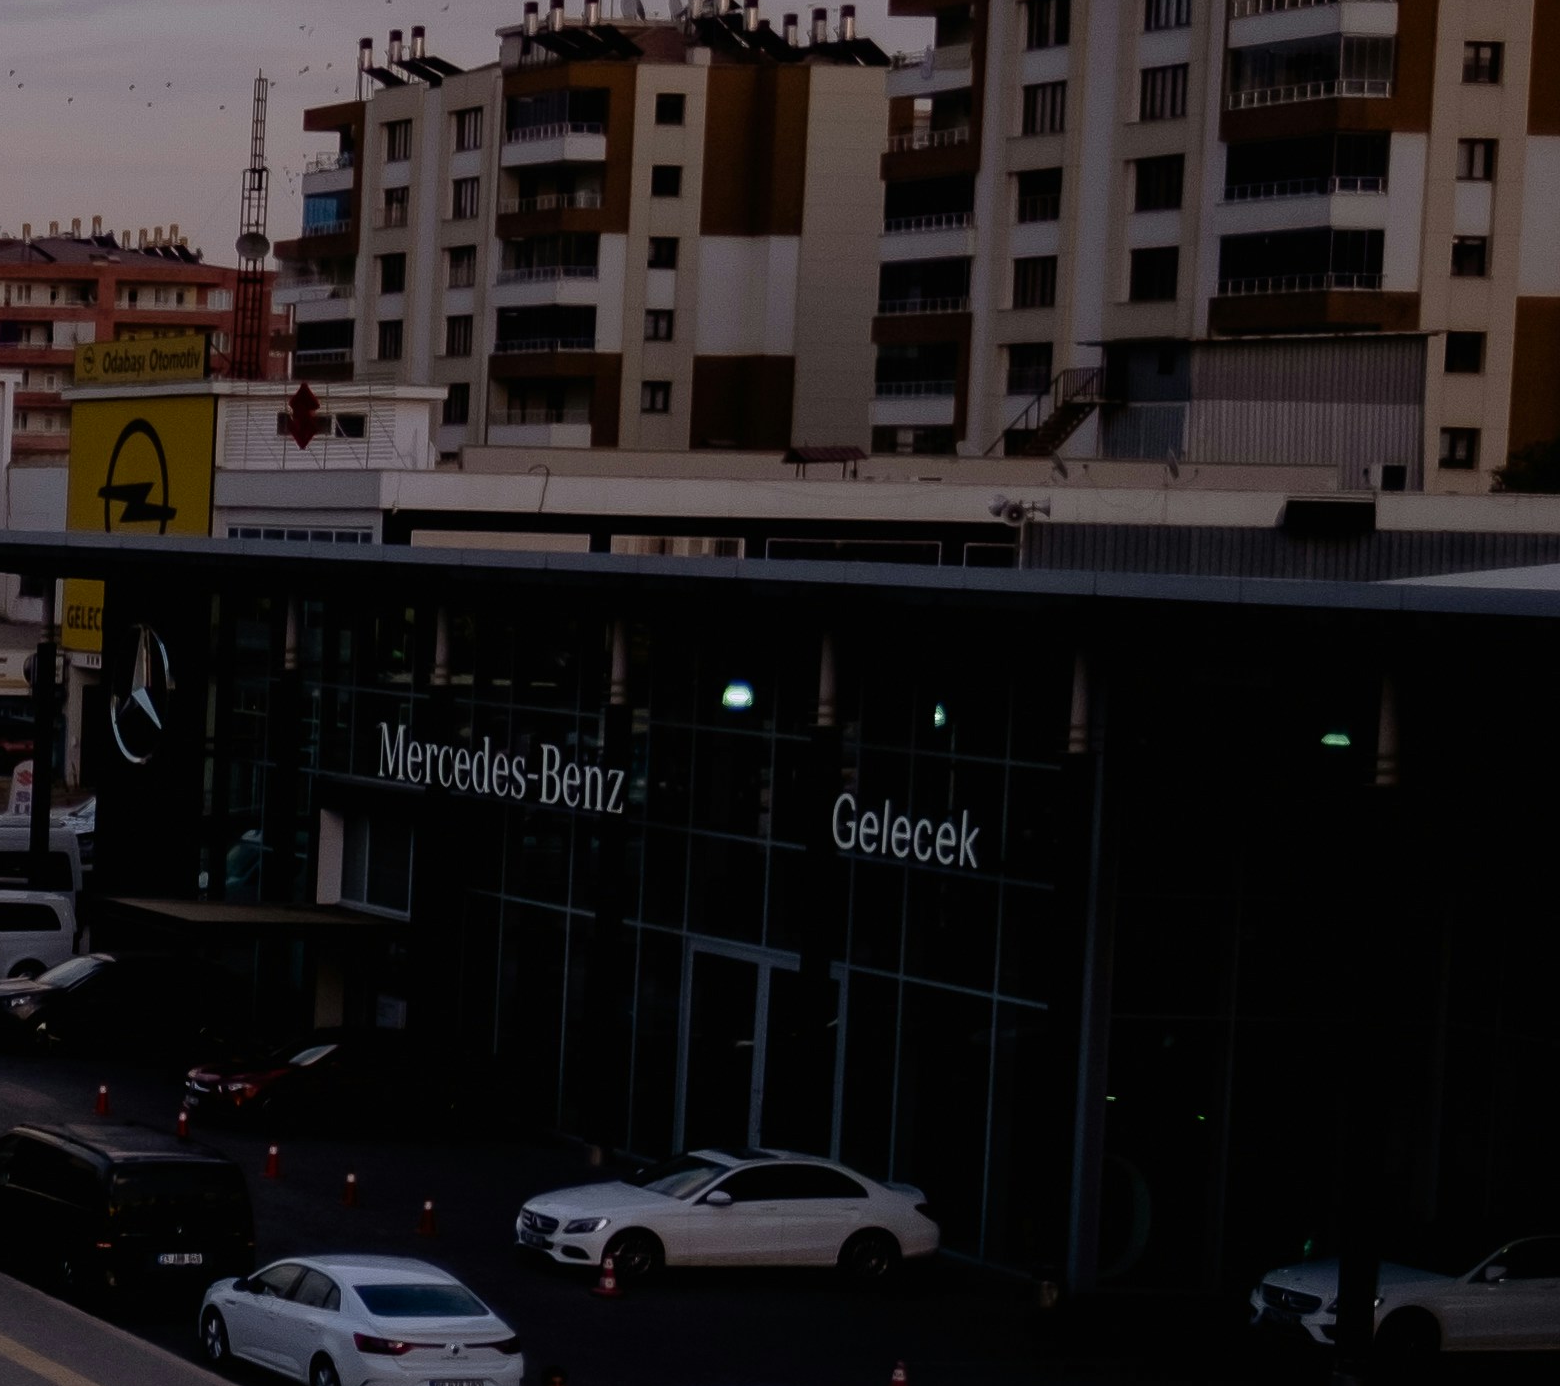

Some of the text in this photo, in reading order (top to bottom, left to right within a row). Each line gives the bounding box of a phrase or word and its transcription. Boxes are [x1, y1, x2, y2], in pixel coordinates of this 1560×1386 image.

[102, 350, 145, 377] Odabaşı
[376, 721, 625, 814] Mercedes-Benz
[832, 792, 980, 869] Gelecek
